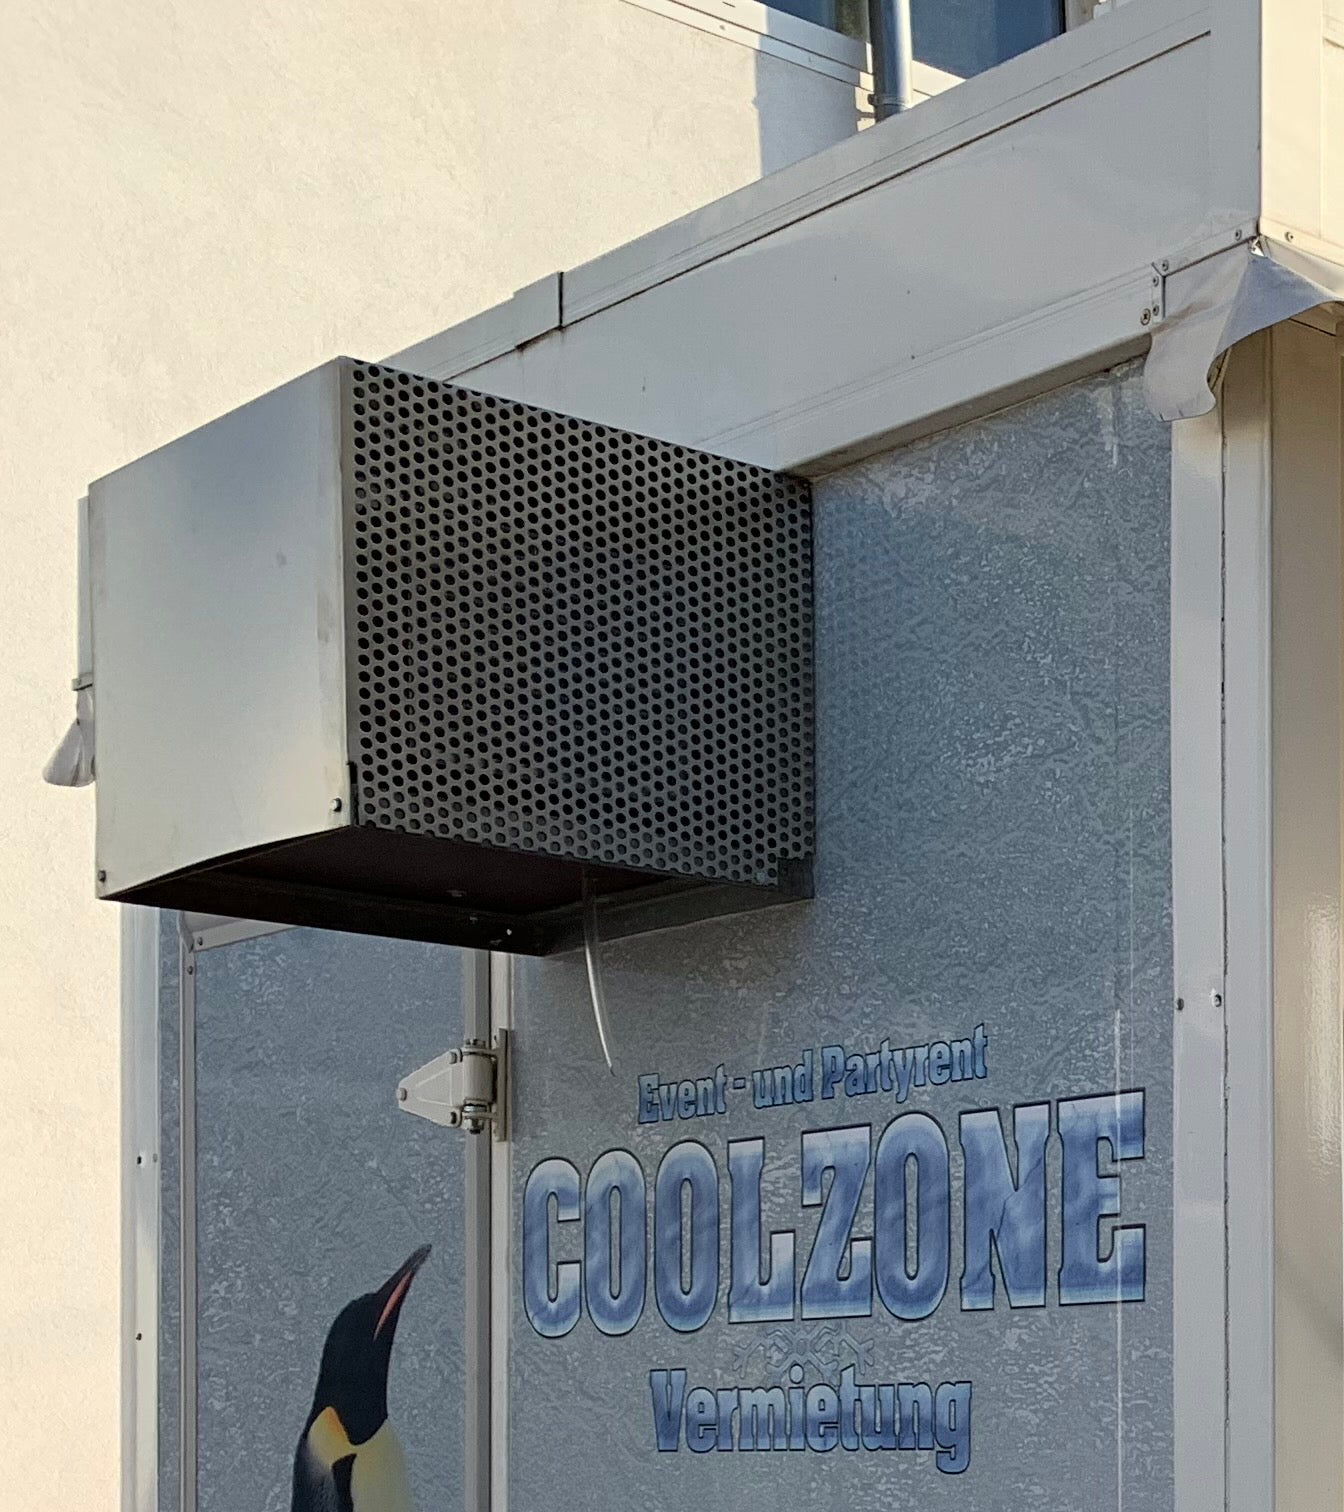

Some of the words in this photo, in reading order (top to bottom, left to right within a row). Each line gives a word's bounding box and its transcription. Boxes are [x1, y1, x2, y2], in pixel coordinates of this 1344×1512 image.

[753, 1049, 814, 1109] und
[821, 1023, 988, 1103] Partyrent
[523, 1090, 1146, 1338] COOLZONE
[650, 1364, 971, 1473] Vermietung
